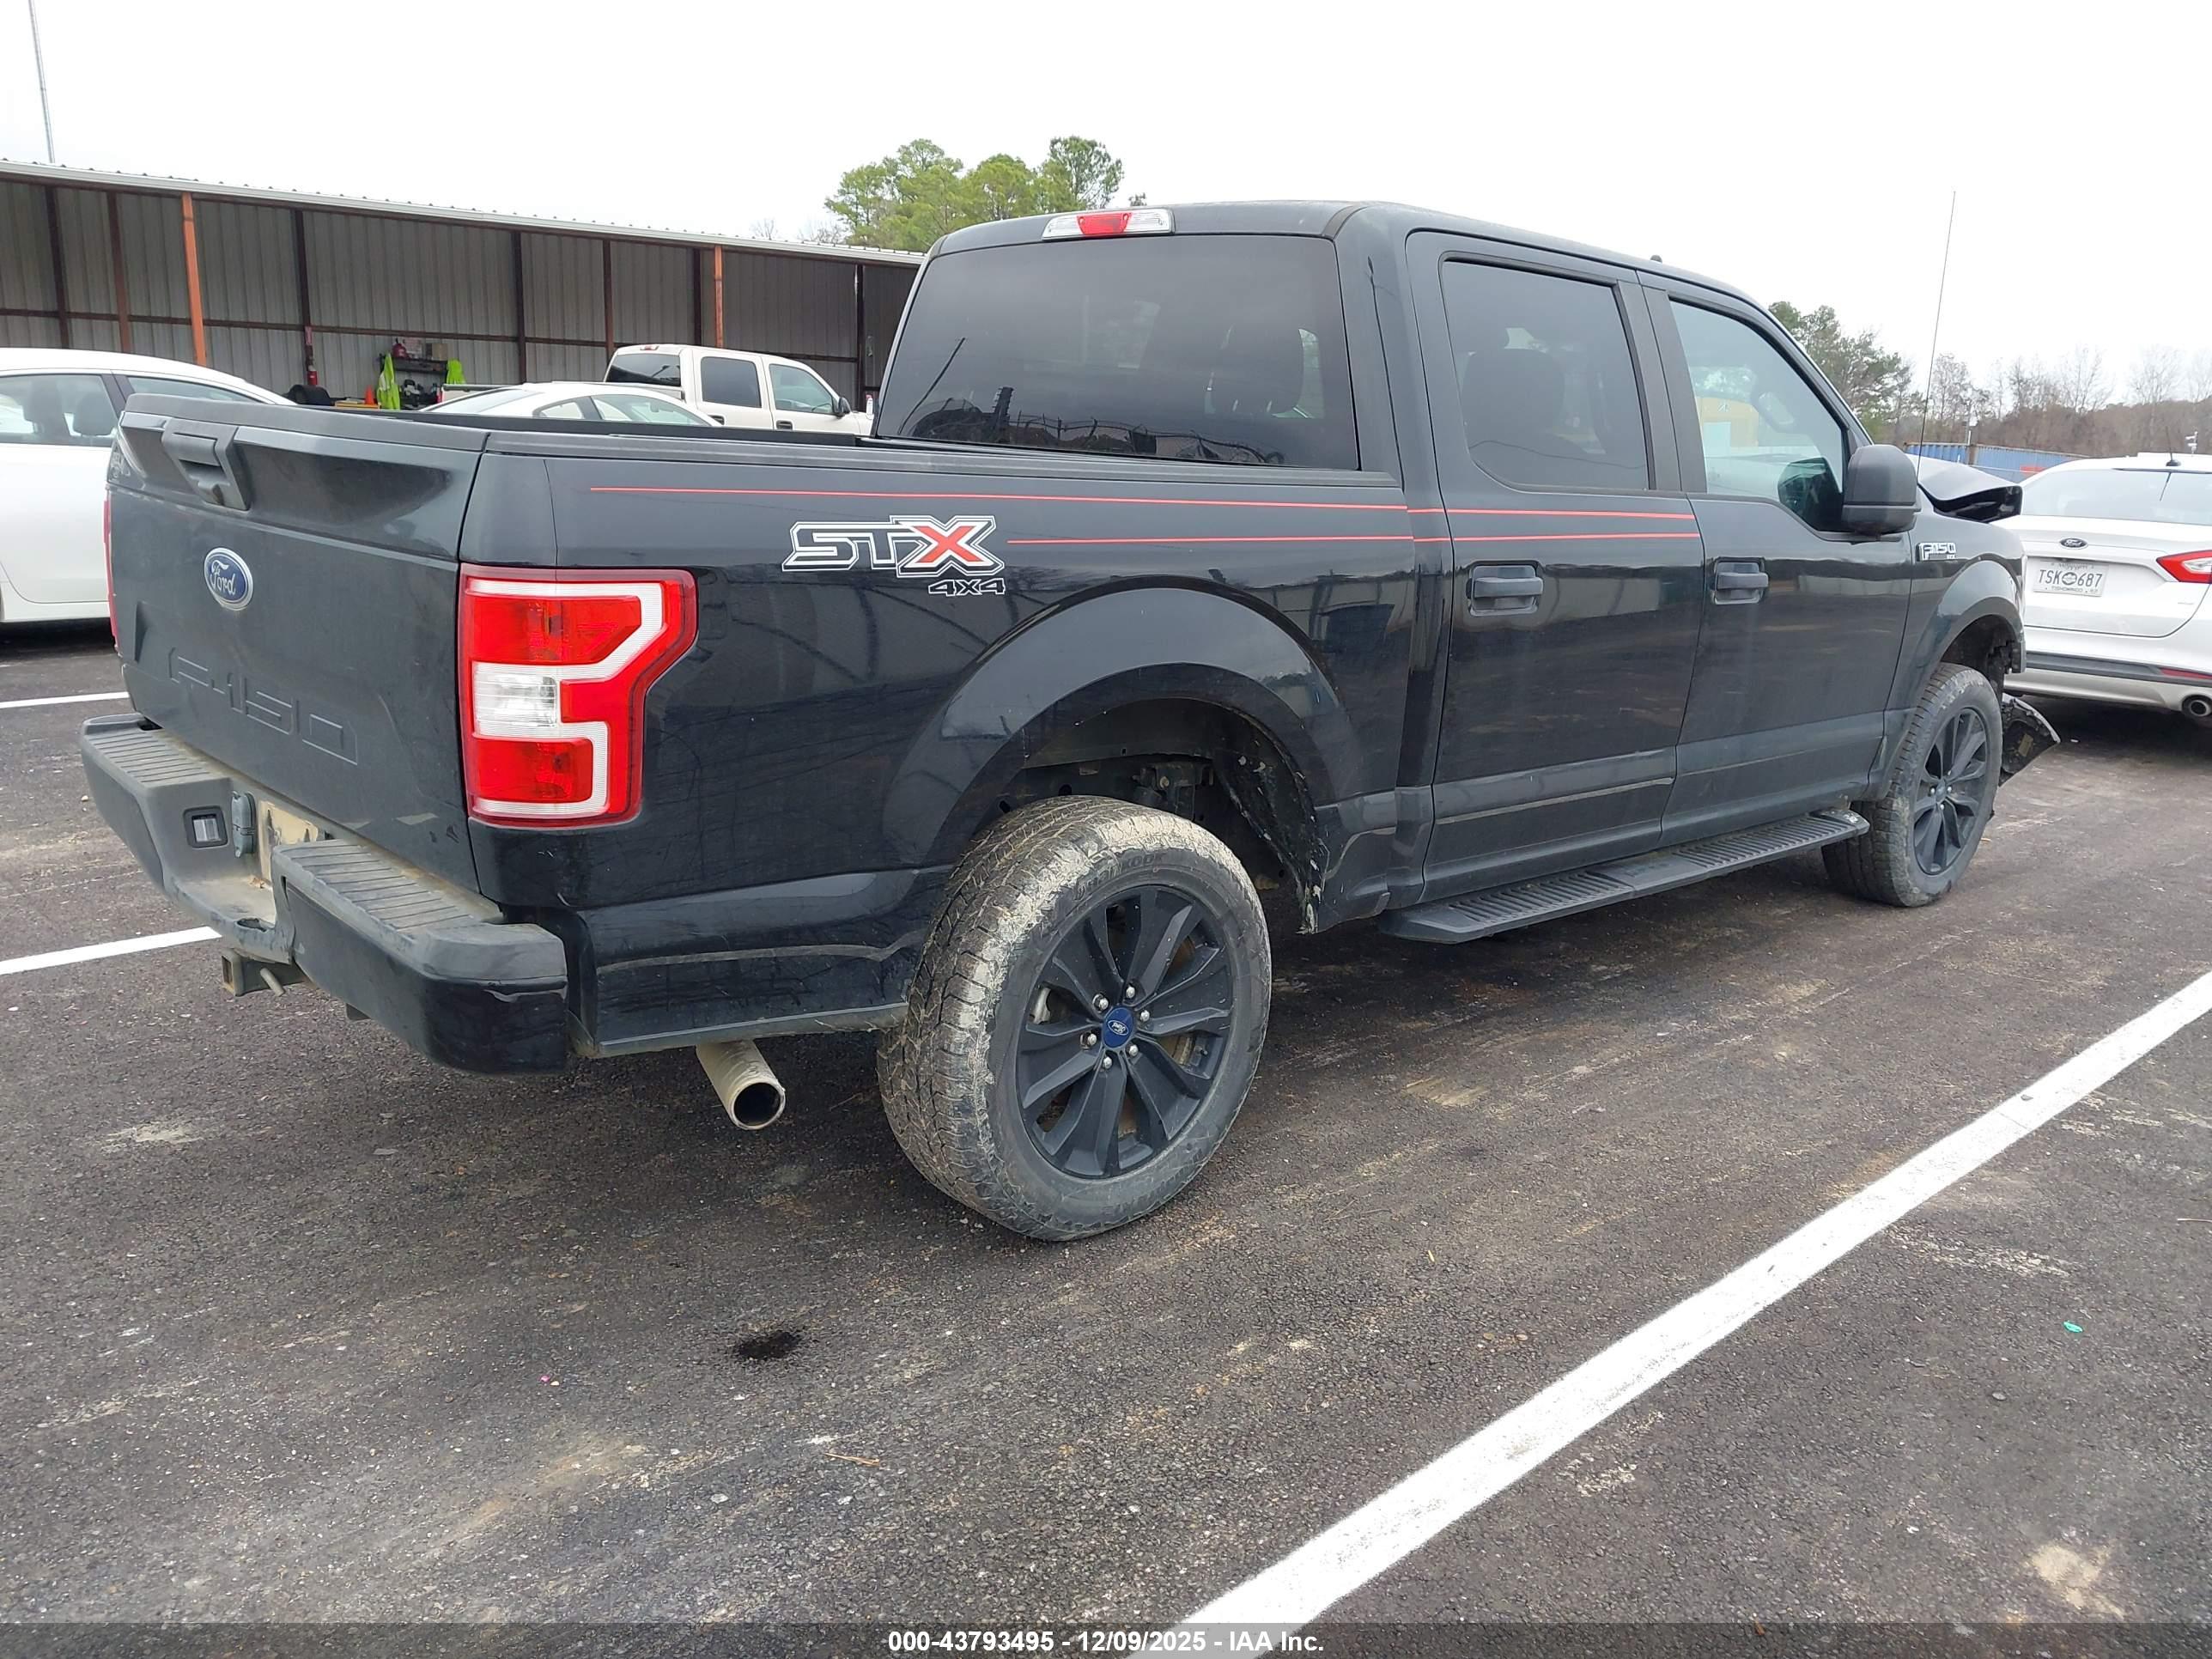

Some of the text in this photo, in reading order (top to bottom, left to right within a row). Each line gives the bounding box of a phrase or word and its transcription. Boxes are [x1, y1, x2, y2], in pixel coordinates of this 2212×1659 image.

[782, 515, 1005, 578] STX
[2039, 568, 2103, 588] TSK 687
